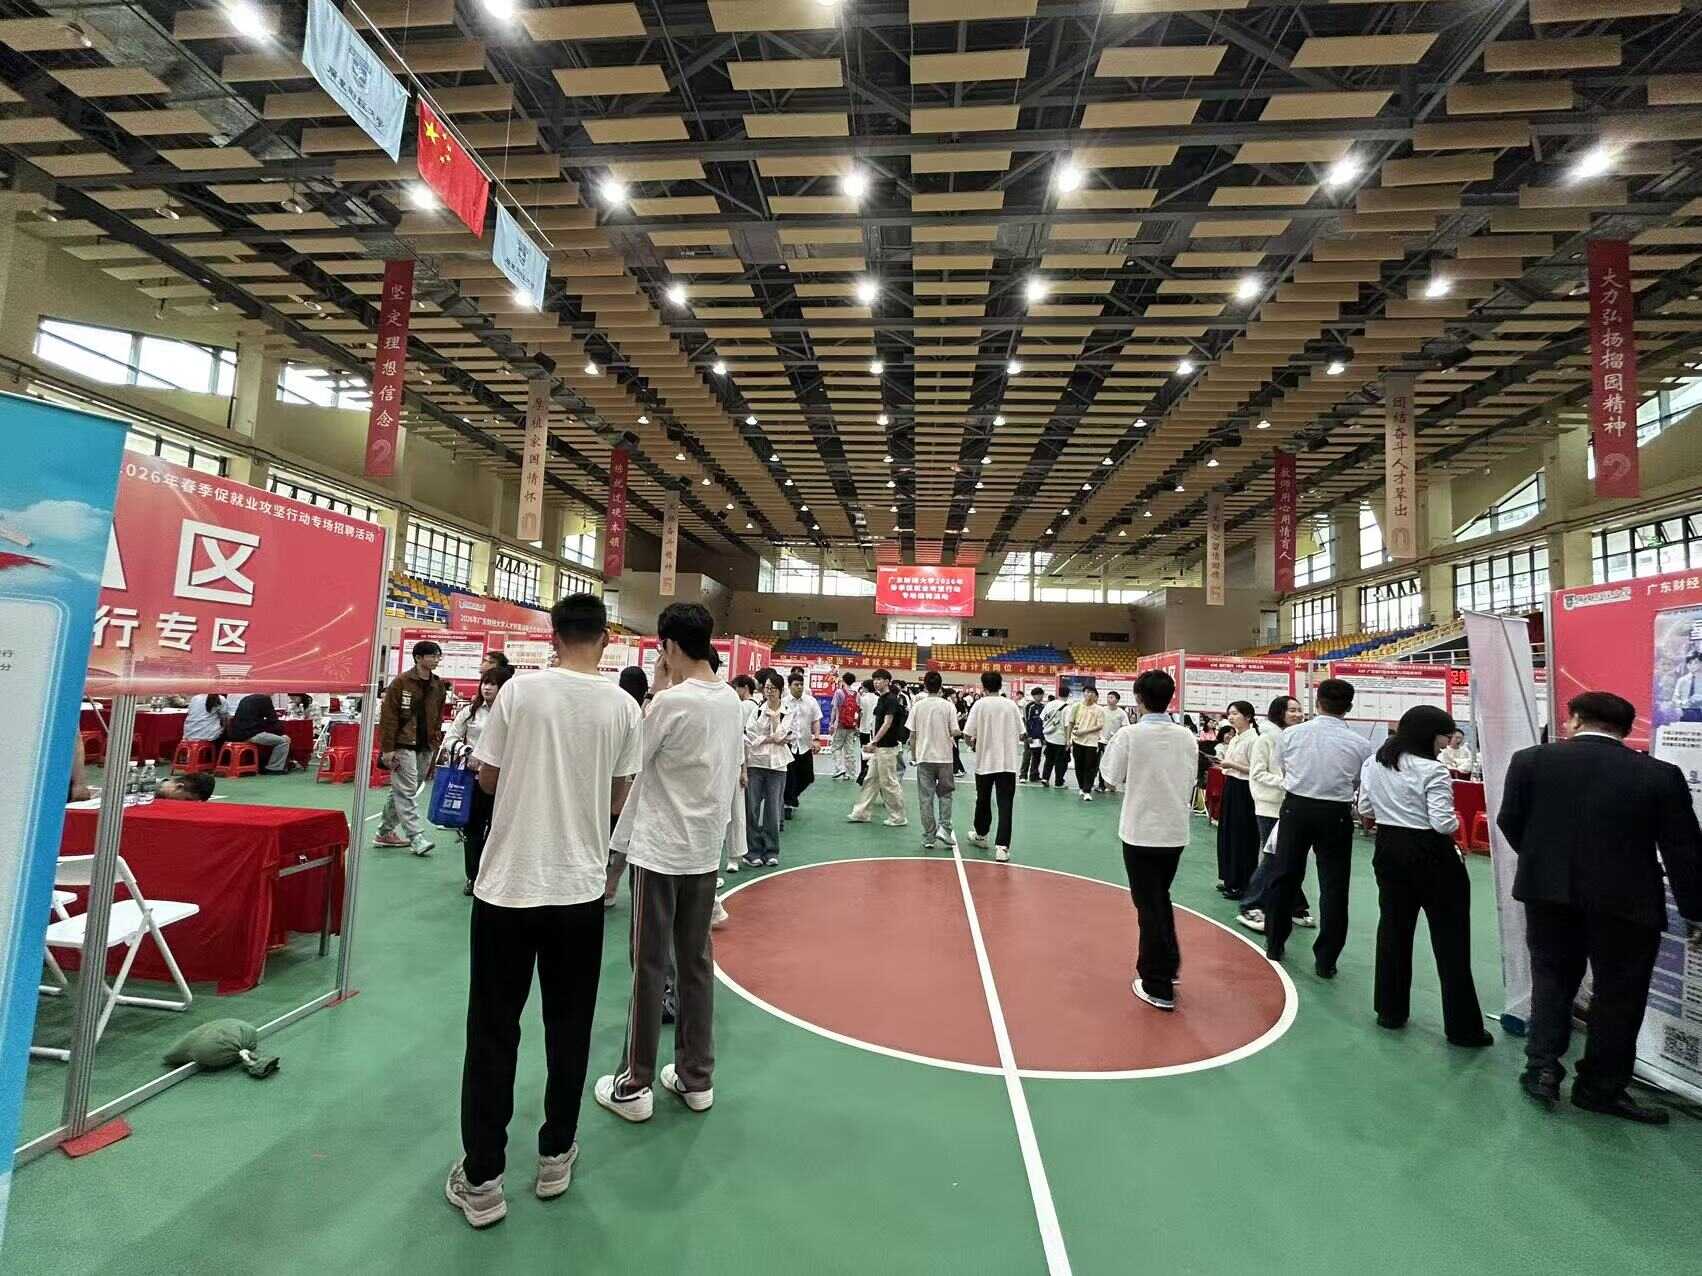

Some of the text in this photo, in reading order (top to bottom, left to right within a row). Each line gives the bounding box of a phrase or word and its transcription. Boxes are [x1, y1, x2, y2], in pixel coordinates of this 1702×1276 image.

[376, 284, 406, 429] 坚定理想信念
[1600, 267, 1627, 437] 大力弘扬榴园精神
[121, 464, 376, 543] 026年春季促就业攻坚行动专场招聘活动
[1647, 577, 1701, 595] 广东财经
[92, 605, 248, 653] 行专区
